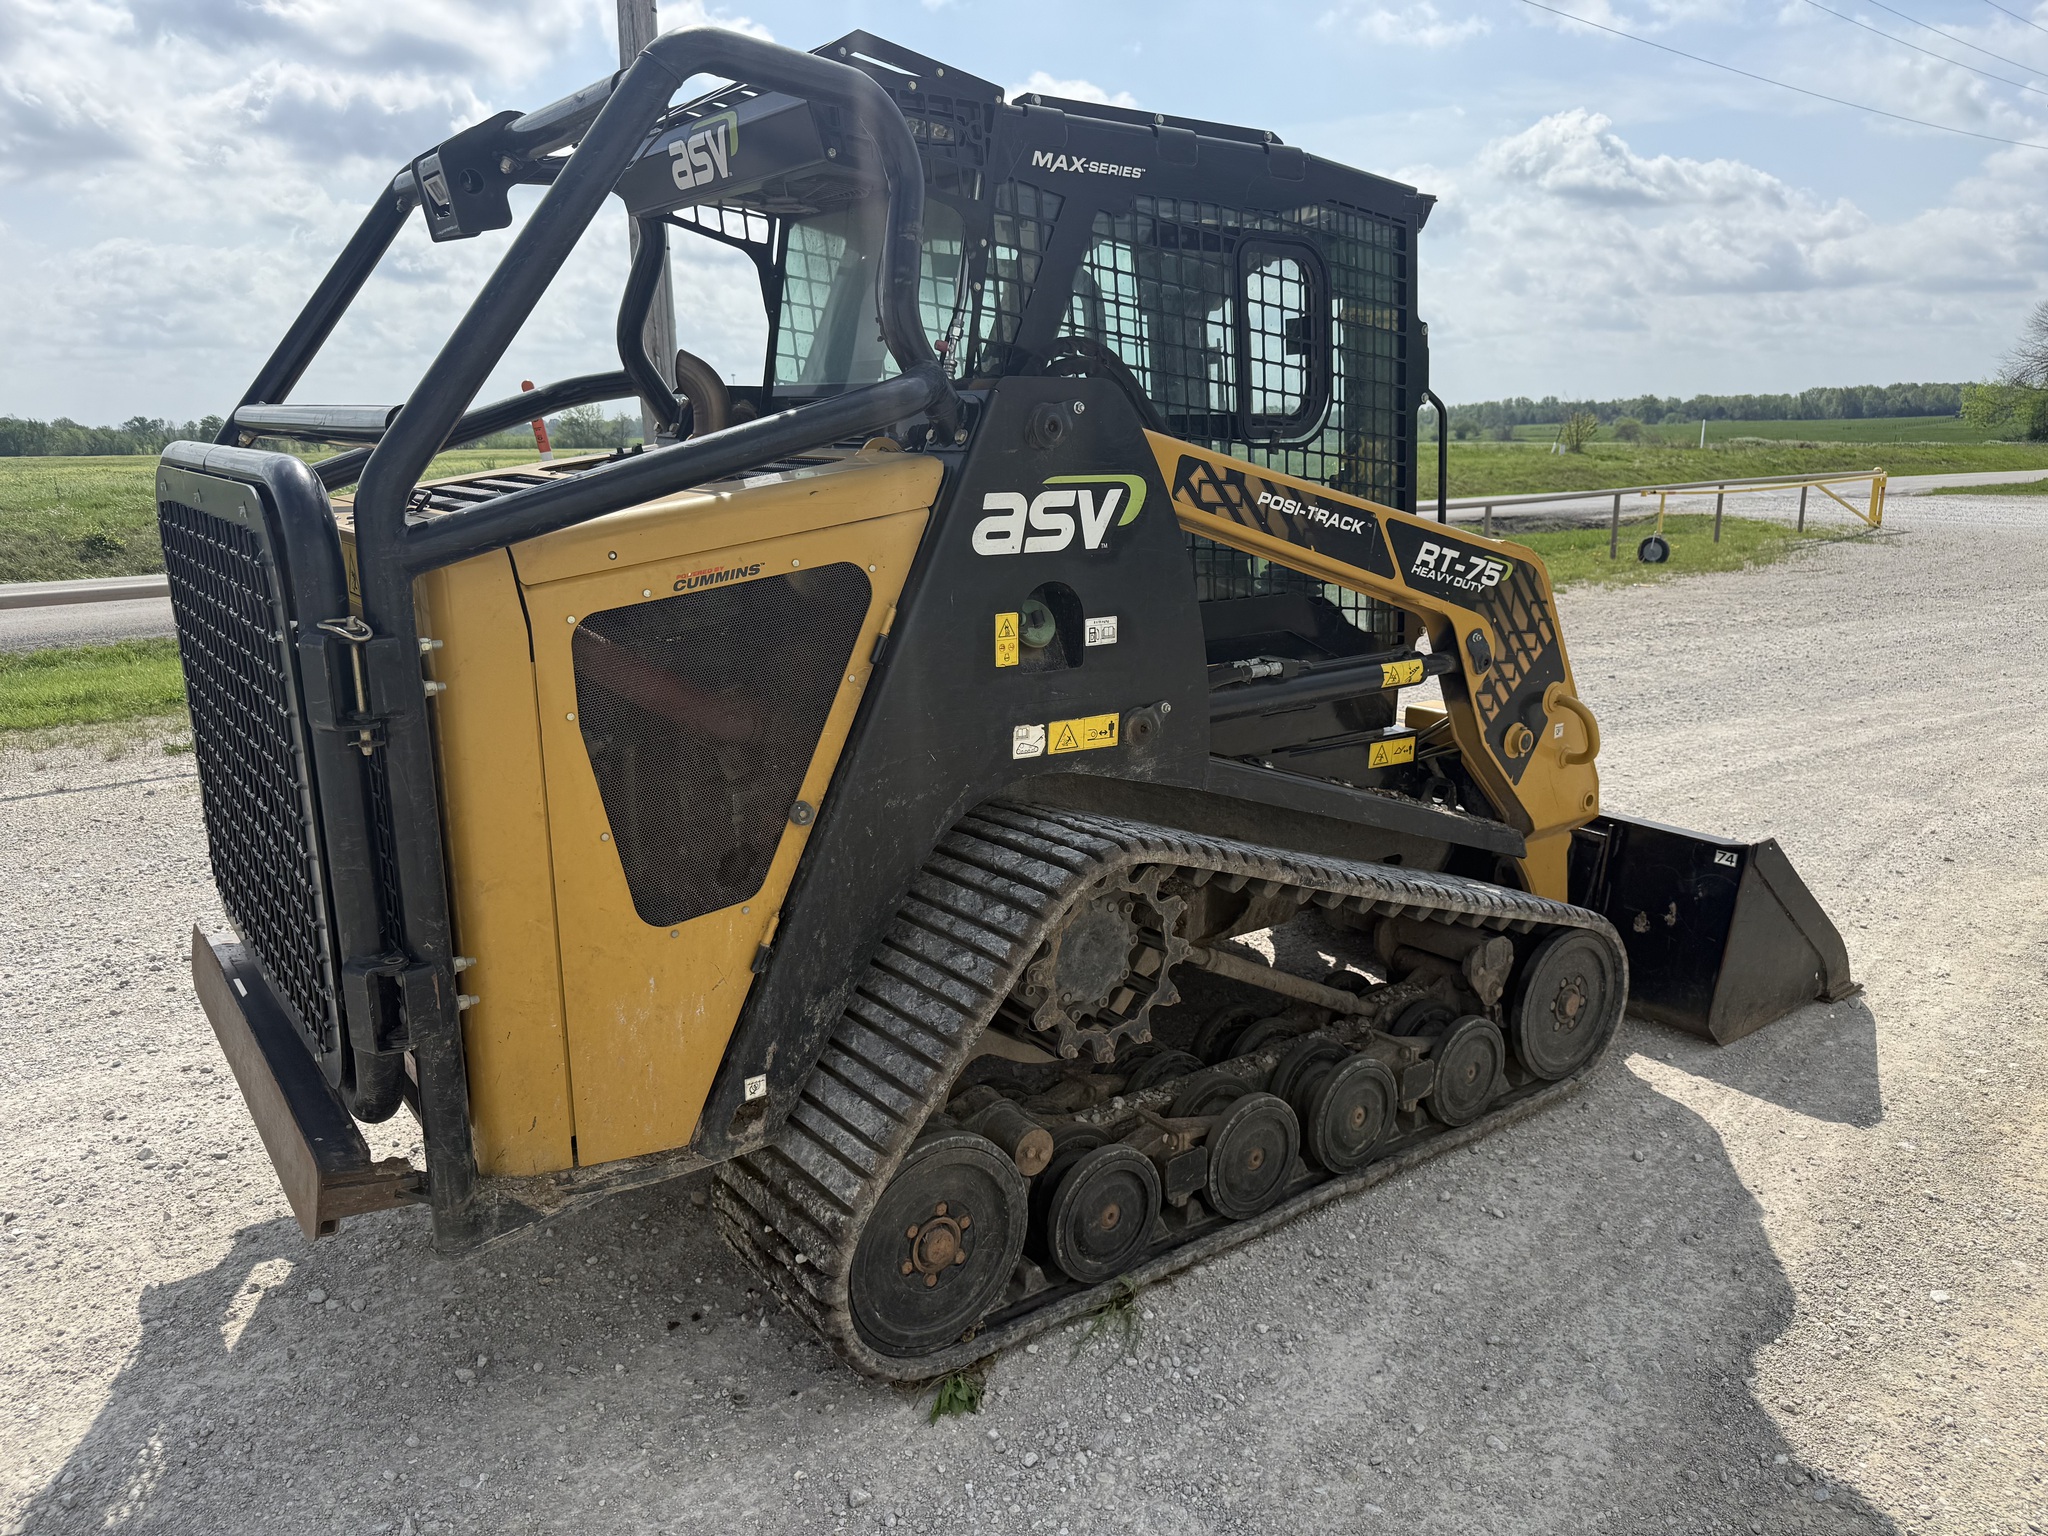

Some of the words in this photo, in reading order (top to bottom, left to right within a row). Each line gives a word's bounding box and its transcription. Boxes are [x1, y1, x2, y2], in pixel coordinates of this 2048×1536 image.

[673, 563, 761, 592] CUMMINS
[676, 569, 713, 579] POWERED
[713, 566, 725, 574] BY
[1411, 564, 1454, 584] HEAVY
[1453, 577, 1486, 592] DUTY
[1415, 541, 1504, 587] RT-75
[1717, 851, 1735, 865] 74
